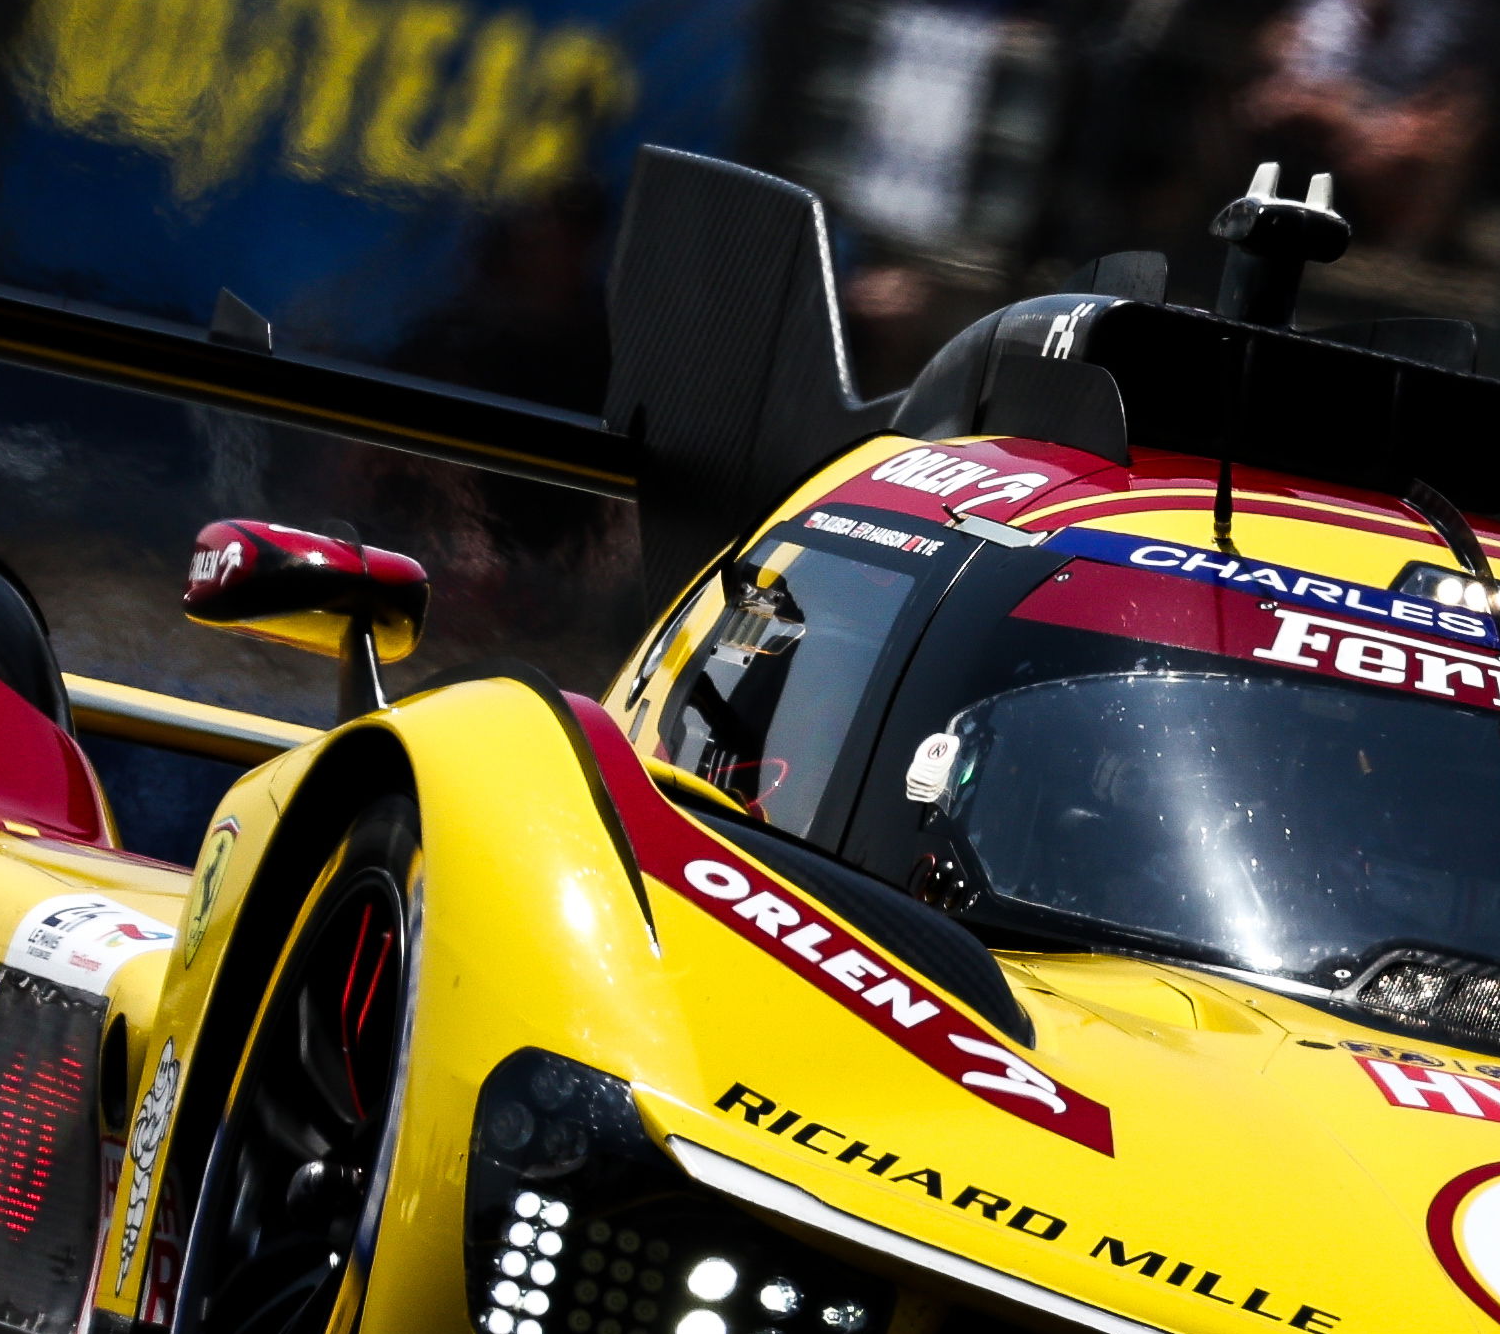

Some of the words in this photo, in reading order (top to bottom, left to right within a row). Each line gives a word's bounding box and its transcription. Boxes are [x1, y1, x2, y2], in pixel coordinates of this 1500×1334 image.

[871, 448, 998, 497] ORLEN
[1128, 544, 1490, 639] CHARLES
[683, 859, 941, 1029] ORLEN
[714, 1082, 1068, 1242] RICHARD
